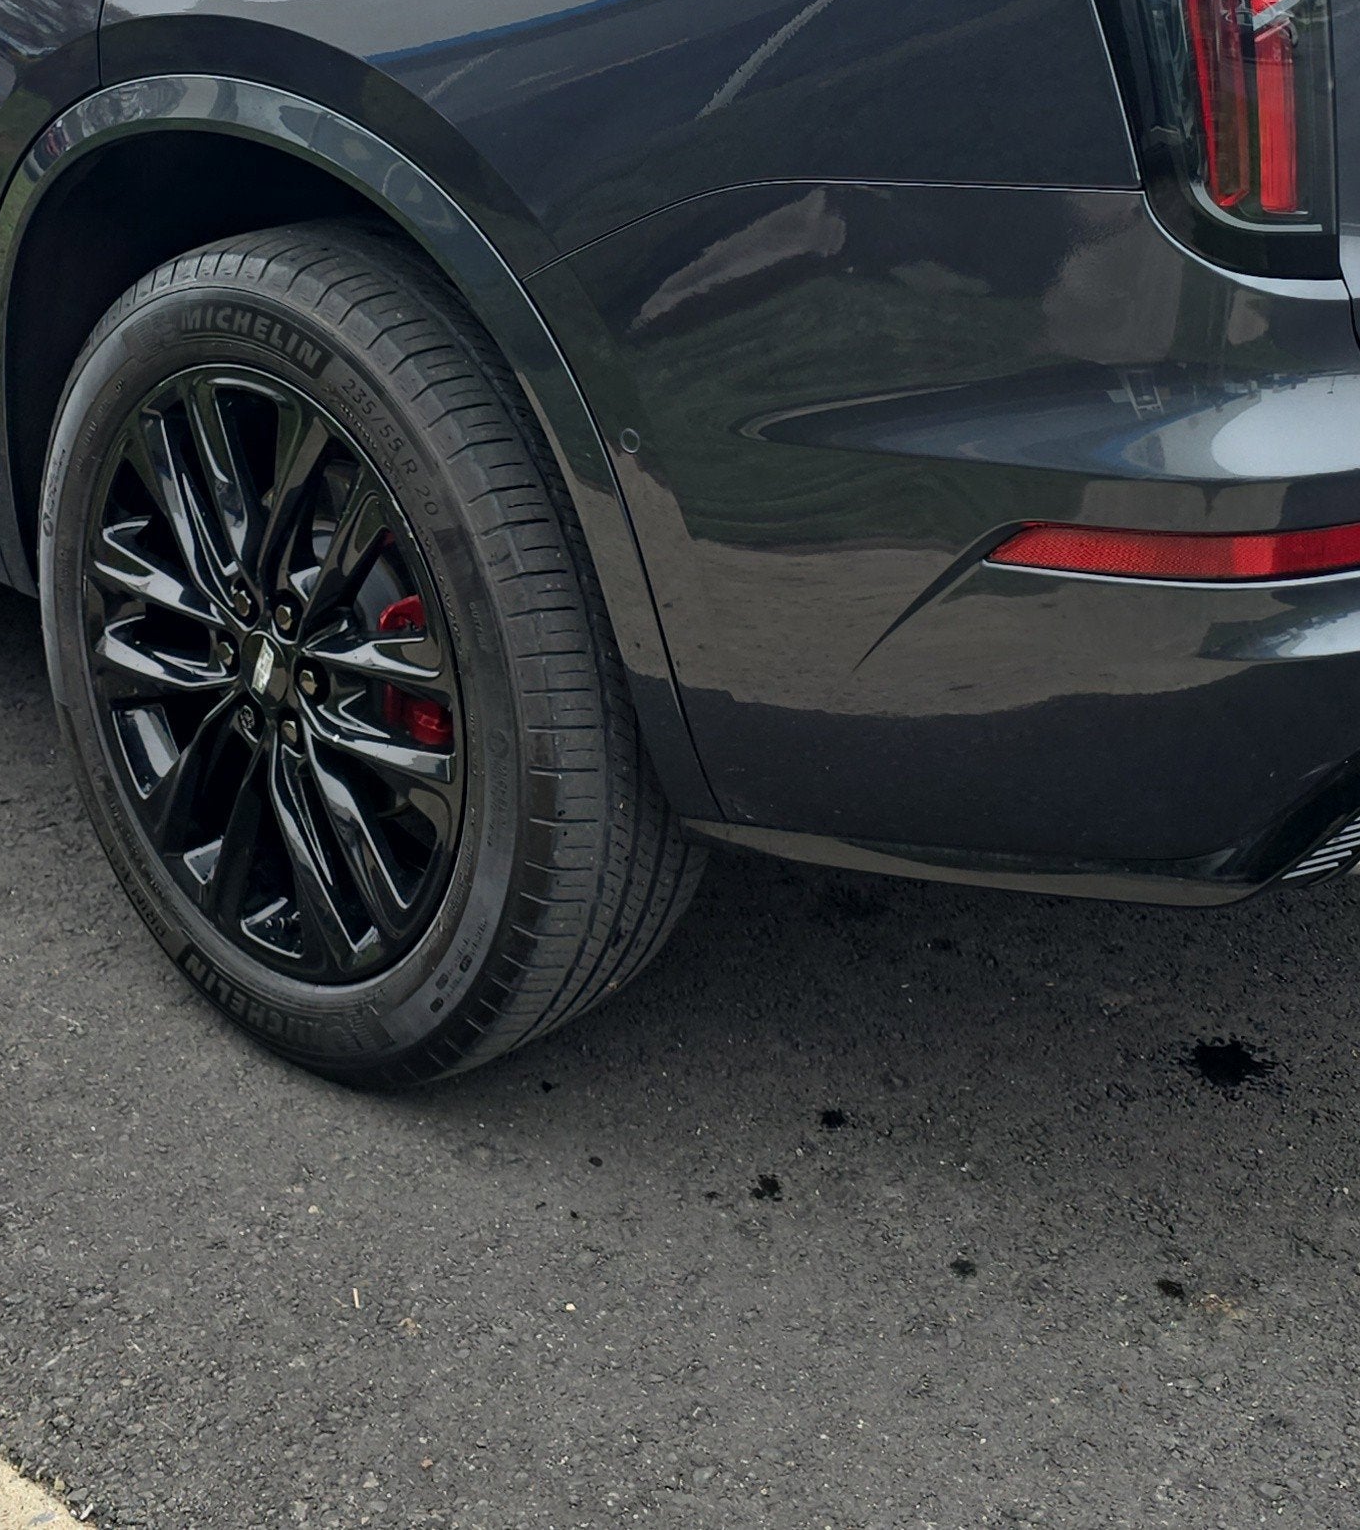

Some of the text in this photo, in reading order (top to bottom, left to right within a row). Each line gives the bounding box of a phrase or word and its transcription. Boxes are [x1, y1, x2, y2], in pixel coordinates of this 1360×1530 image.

[180, 305, 323, 370] MICHELIN
[340, 378, 440, 518] 235/55 R 20
